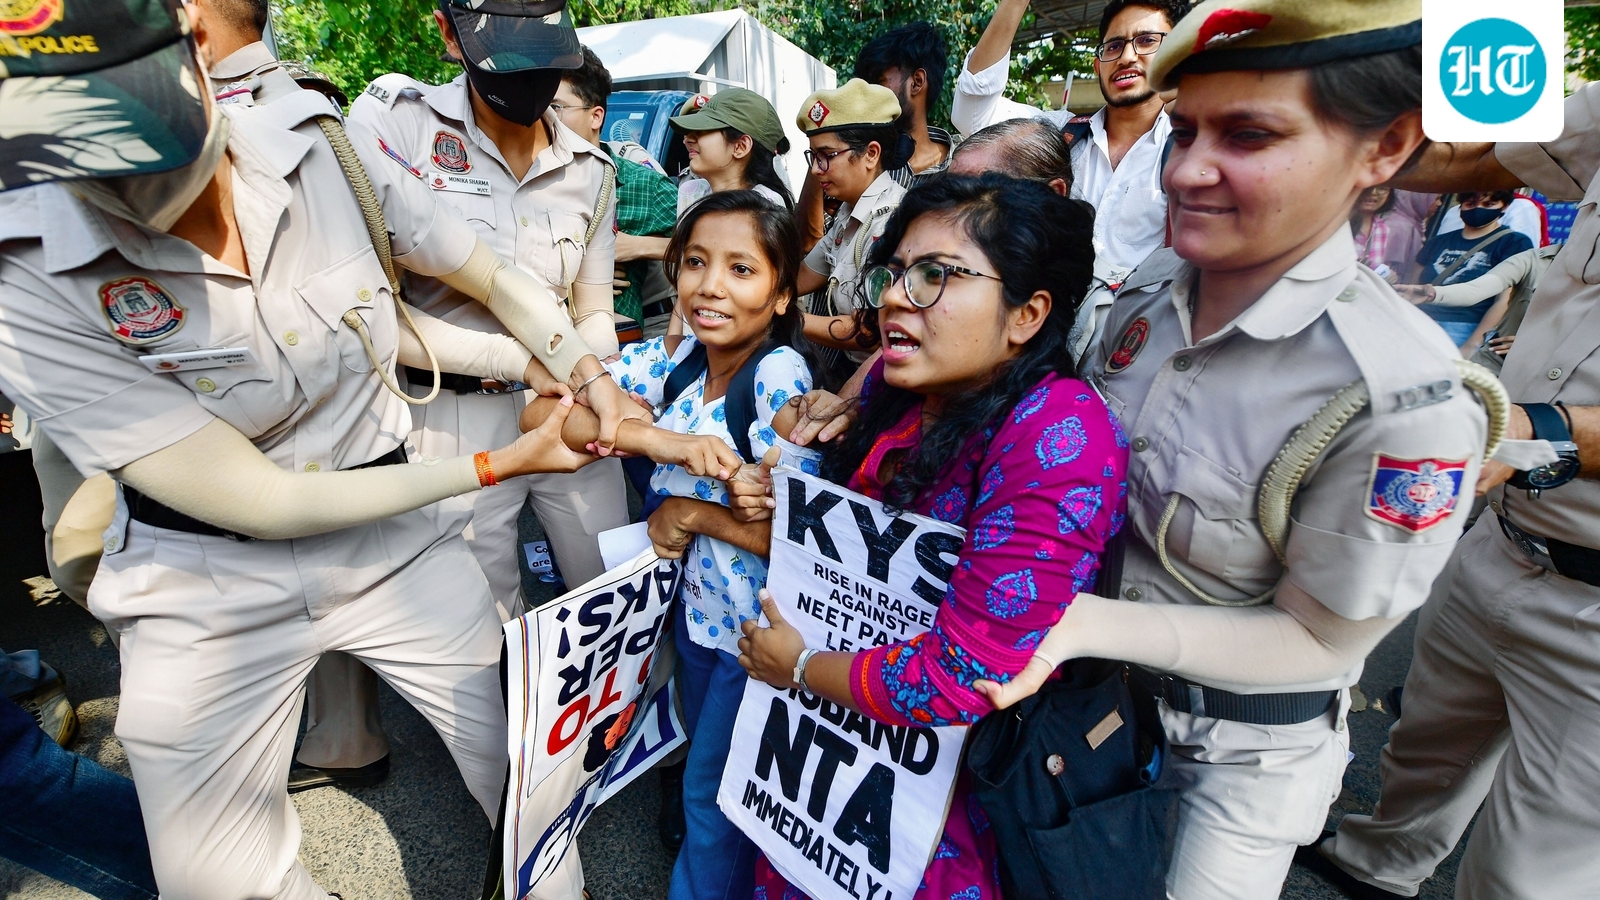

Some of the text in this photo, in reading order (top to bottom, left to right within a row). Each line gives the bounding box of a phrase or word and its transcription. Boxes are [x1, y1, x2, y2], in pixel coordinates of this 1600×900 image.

[18, 35, 99, 55] POLICE
[448, 176, 490, 187] MONIKA SHARMA
[532, 559, 550, 568] are
[787, 477, 966, 608] KYS
[797, 592, 904, 648] NEET PA
[814, 563, 932, 629] RISE IN RAGE
[829, 589, 909, 636] AGAINST
[826, 631, 868, 652] LE
[766, 682, 939, 776] BAND
[755, 697, 895, 874] NTA
